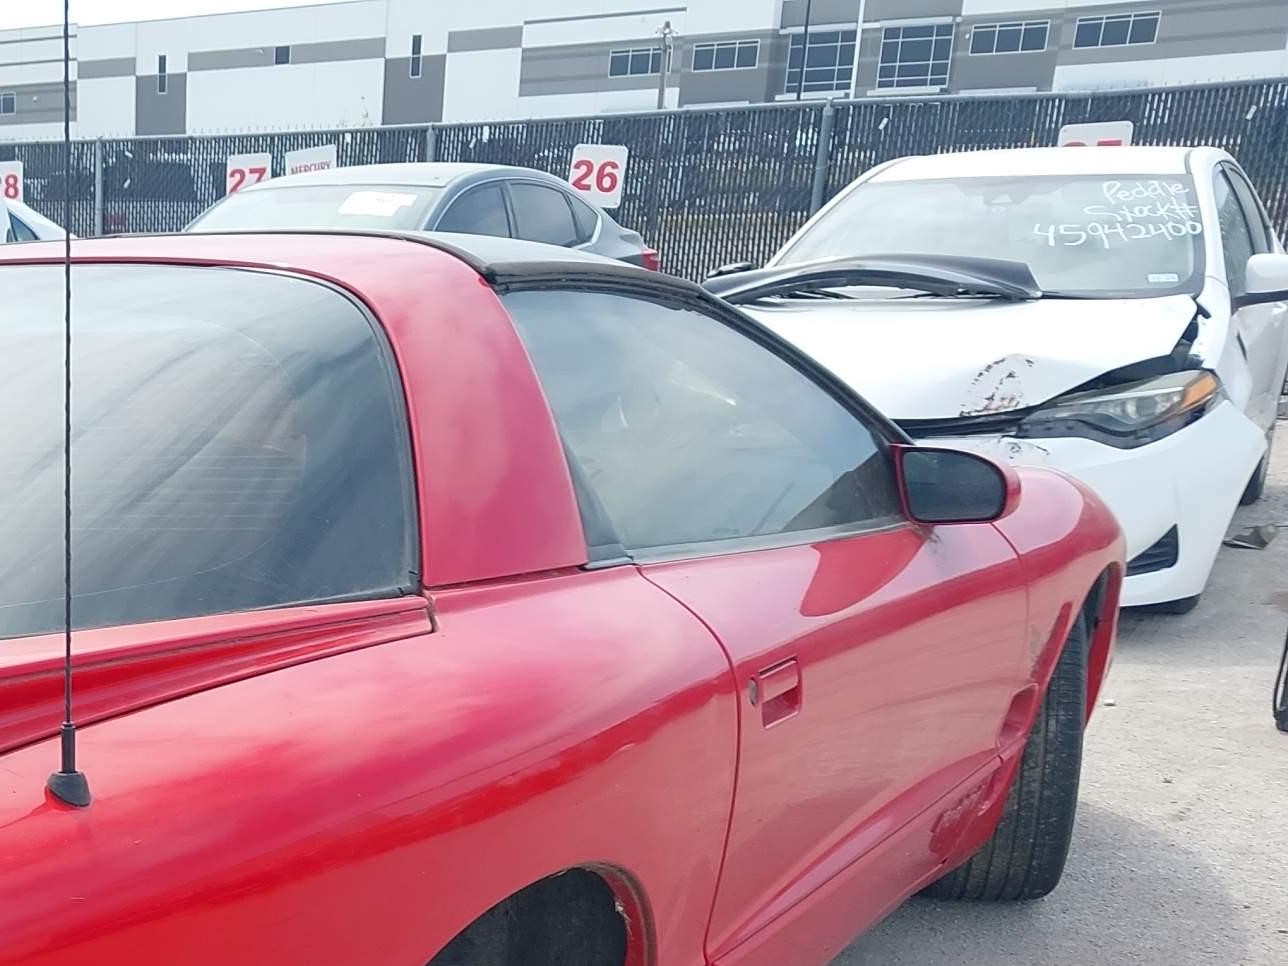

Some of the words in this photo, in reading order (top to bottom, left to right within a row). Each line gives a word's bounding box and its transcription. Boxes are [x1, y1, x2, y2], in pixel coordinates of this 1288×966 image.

[228, 166, 267, 194] 27
[572, 159, 619, 193] 26
[1102, 179, 1190, 204] Peddle
[1032, 220, 1203, 249] 45942400
